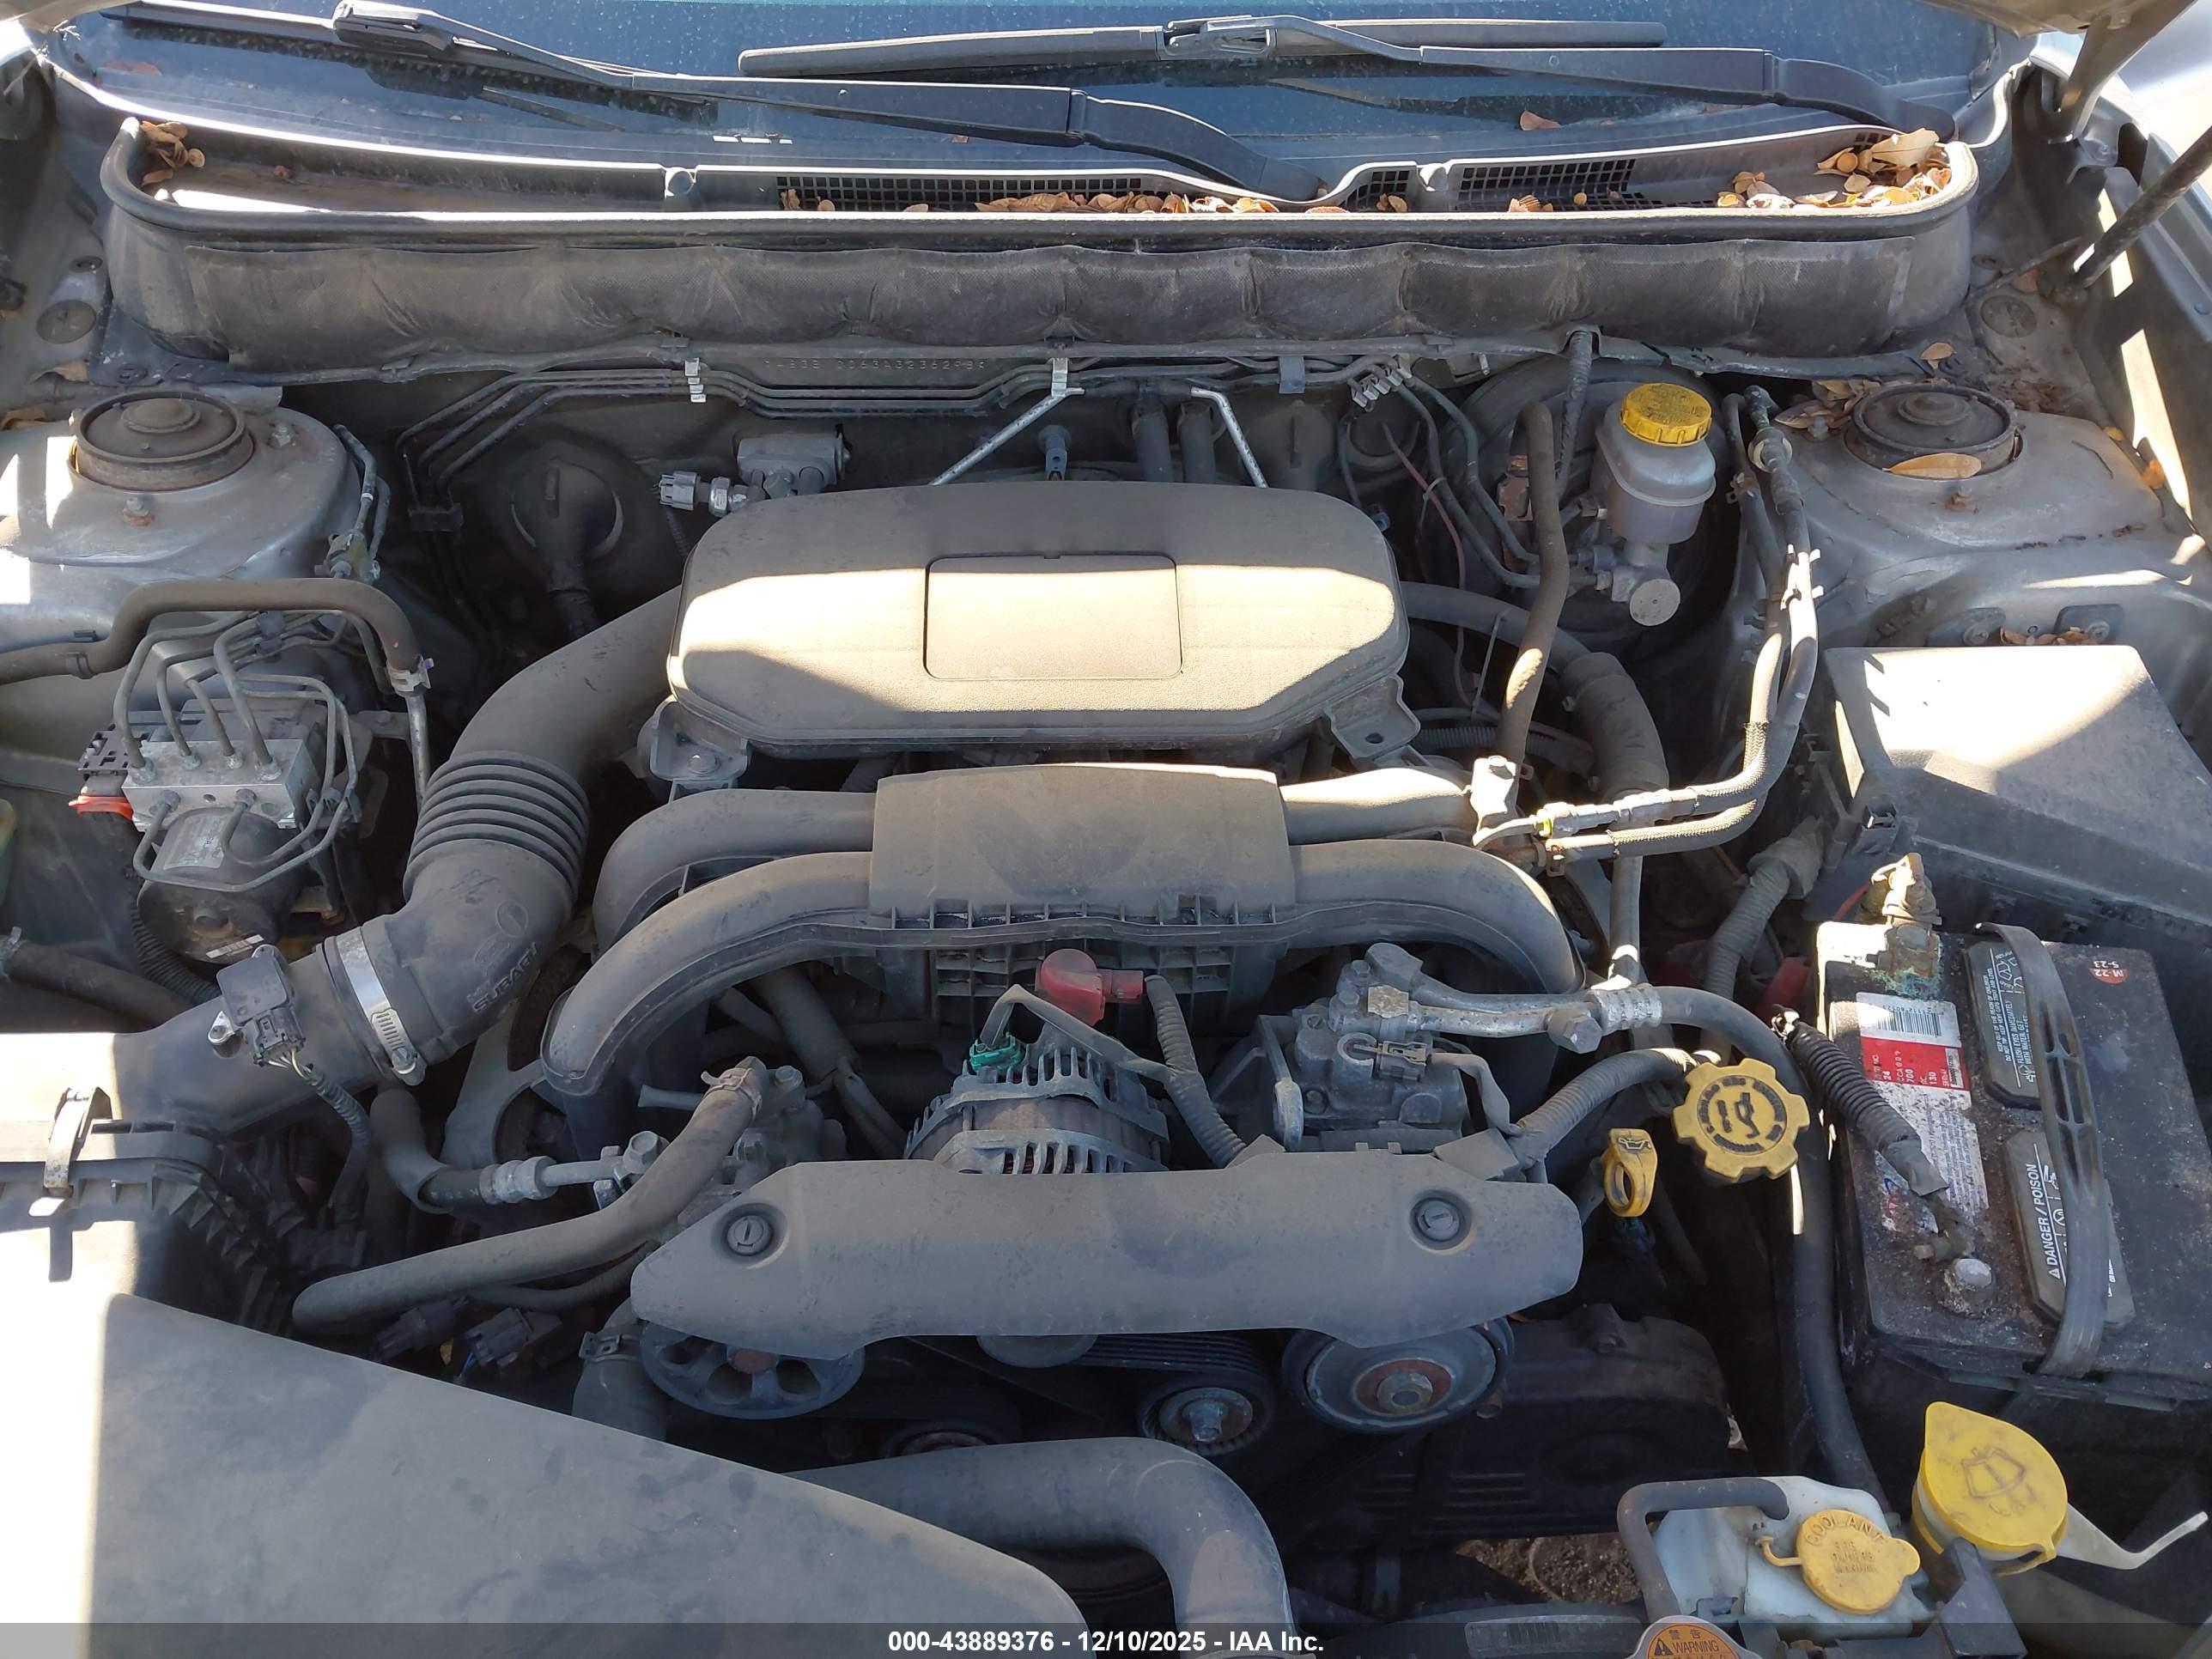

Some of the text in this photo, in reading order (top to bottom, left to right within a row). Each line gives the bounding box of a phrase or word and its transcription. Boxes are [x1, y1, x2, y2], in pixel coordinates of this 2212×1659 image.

[2004, 1000, 2024, 1064] FLUSH EYES IMMEDIATELY
[2022, 1052, 2032, 1064] WITH
[1927, 1071, 1938, 1085] 130
[2026, 1164, 2057, 1265] DANGER / POISON
[1673, 1640, 1719, 1653] WARNING
